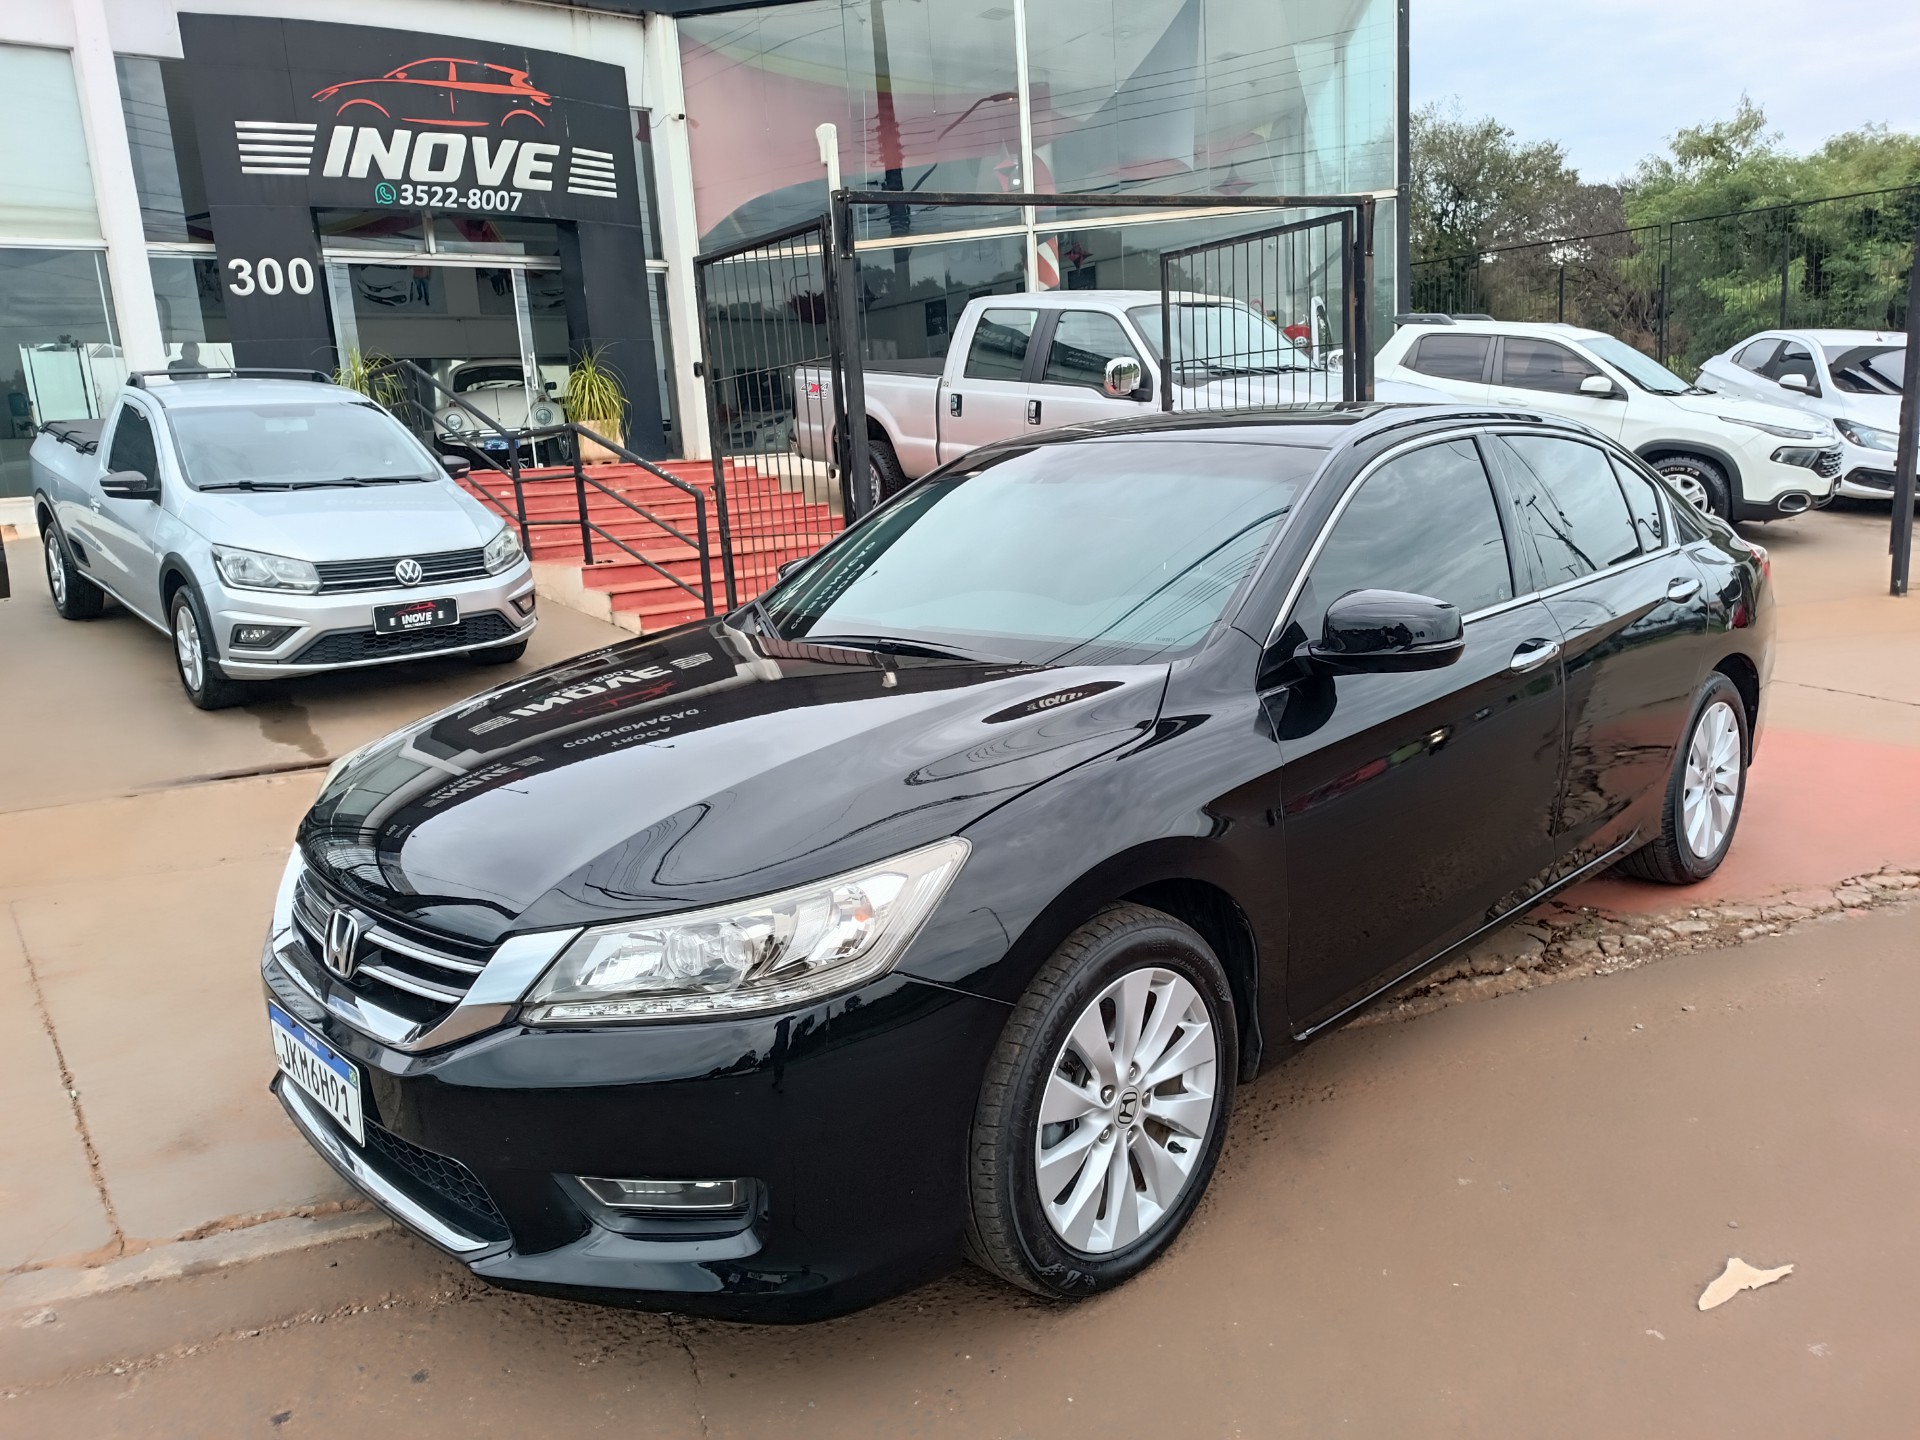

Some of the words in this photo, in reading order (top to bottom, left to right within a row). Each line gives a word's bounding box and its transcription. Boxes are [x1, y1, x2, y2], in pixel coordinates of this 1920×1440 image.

[322, 125, 560, 192] INOVE
[399, 183, 523, 213] 3522-8007
[228, 256, 315, 297] 300
[401, 611, 432, 625] INOVE
[281, 1033, 352, 1127] JKM6H91
